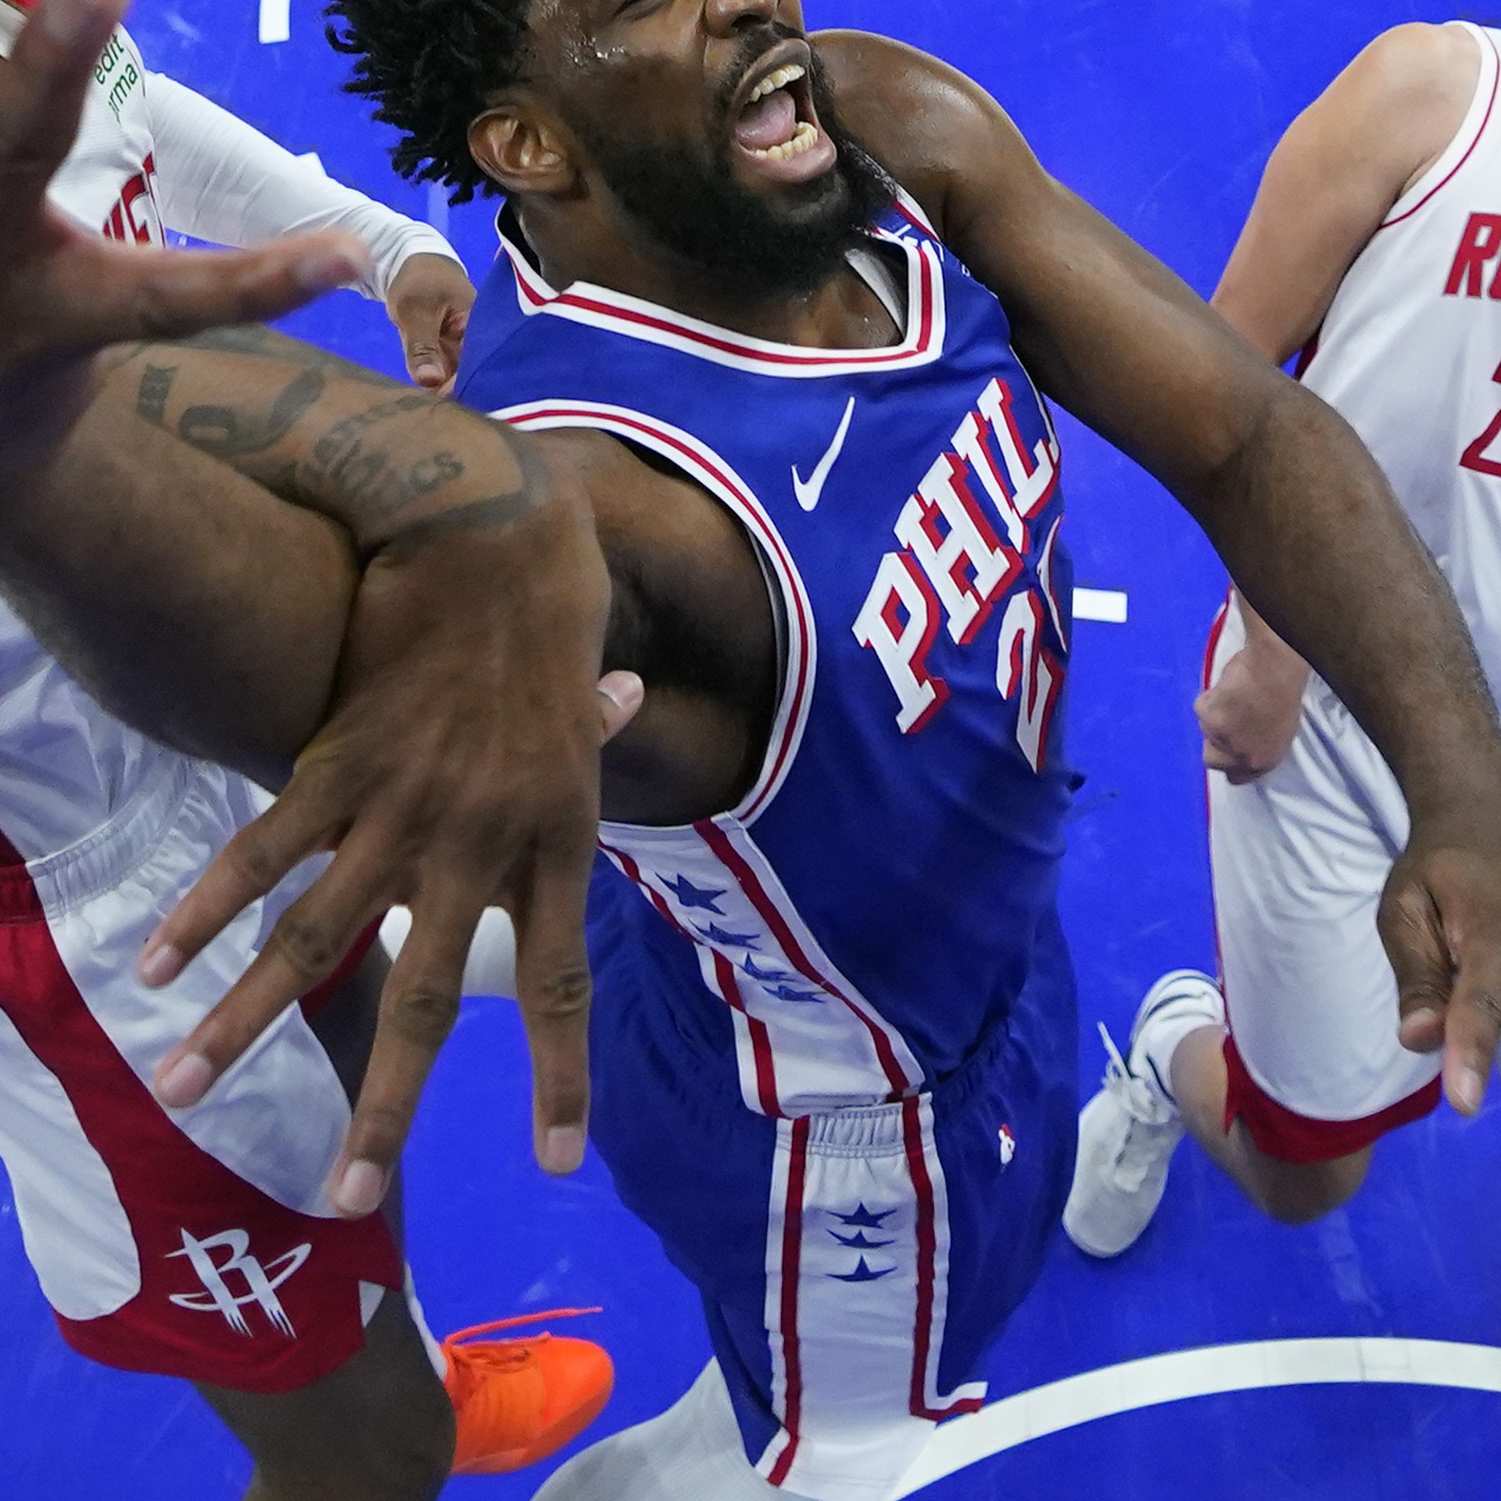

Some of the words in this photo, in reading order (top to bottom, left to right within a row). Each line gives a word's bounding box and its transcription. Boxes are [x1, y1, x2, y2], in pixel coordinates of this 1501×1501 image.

[93, 30, 127, 86] edit
[107, 61, 140, 129] rma
[851, 376, 1061, 735] PHIL
